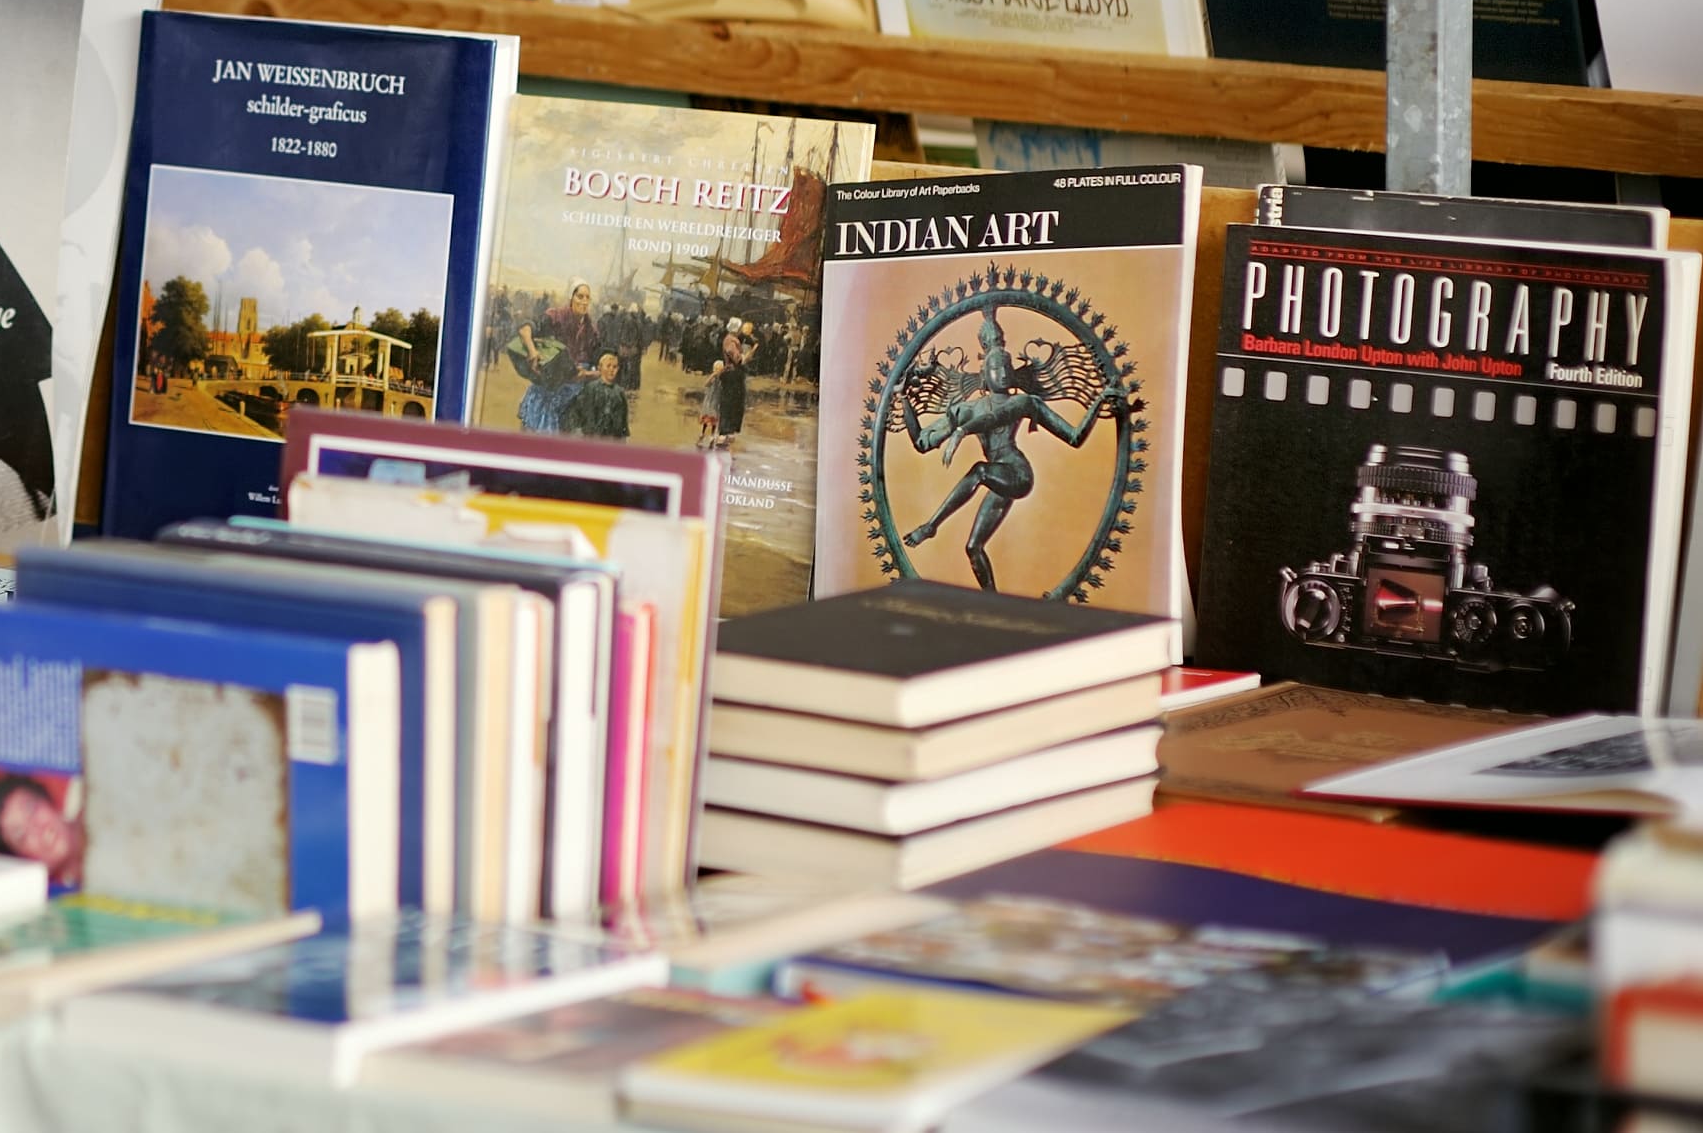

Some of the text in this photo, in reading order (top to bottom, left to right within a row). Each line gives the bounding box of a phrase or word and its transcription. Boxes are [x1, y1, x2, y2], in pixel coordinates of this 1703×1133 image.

[212, 59, 406, 95] JAN WEISSENBRUCH
[246, 94, 368, 124] schilder-graficus
[271, 136, 338, 158] 1822-1880
[564, 166, 793, 215] BOSCH REITZ
[837, 183, 981, 201] The Colour Library of Art Paperbacks
[1053, 173, 1182, 189] 48 PLATES IN FULL COLOUR
[562, 210, 782, 243] SCHILDER EN WERELDREIZIGER
[834, 210, 1060, 256] INDIAN ART
[628, 238, 709, 258] ROND 1900
[1250, 245, 1319, 258] ADAPTED
[1326, 253, 1368, 261] FROM
[1376, 255, 1402, 265] THE
[1409, 259, 1443, 268] LIFE
[1450, 261, 1514, 275] LIBRARY
[1545, 271, 1649, 285] PHOTOGRAPHY
[1242, 261, 1649, 366] PHOTOGRAPHY
[1241, 332, 1523, 378] Barbara London Upton with John Upton
[1548, 362, 1643, 389] Fourth Edition
